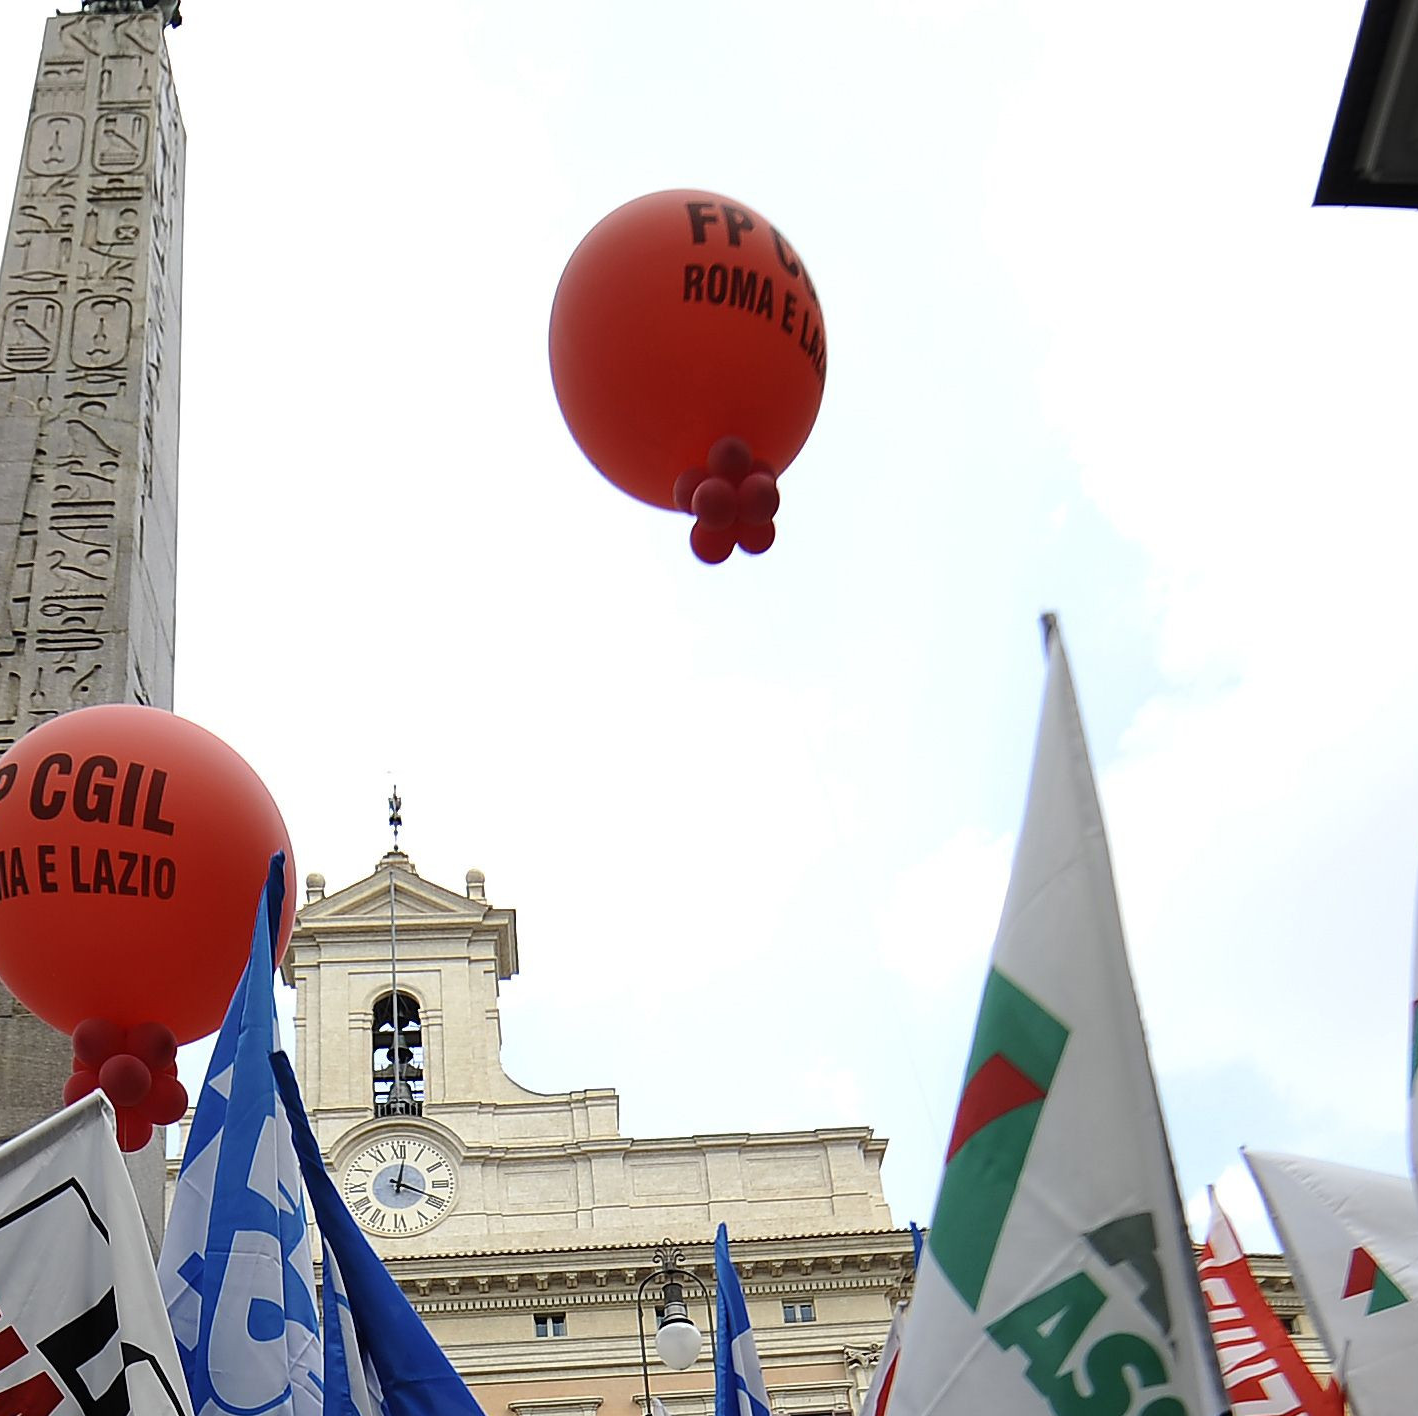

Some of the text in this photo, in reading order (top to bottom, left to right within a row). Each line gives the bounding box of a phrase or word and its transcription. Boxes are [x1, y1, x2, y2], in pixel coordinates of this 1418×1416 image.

[685, 200, 755, 248] FP
[682, 263, 774, 321] ROMA
[781, 290, 799, 335] E
[29, 751, 176, 836] CGIL
[37, 844, 59, 893] E
[70, 845, 177, 900] LAZIO
